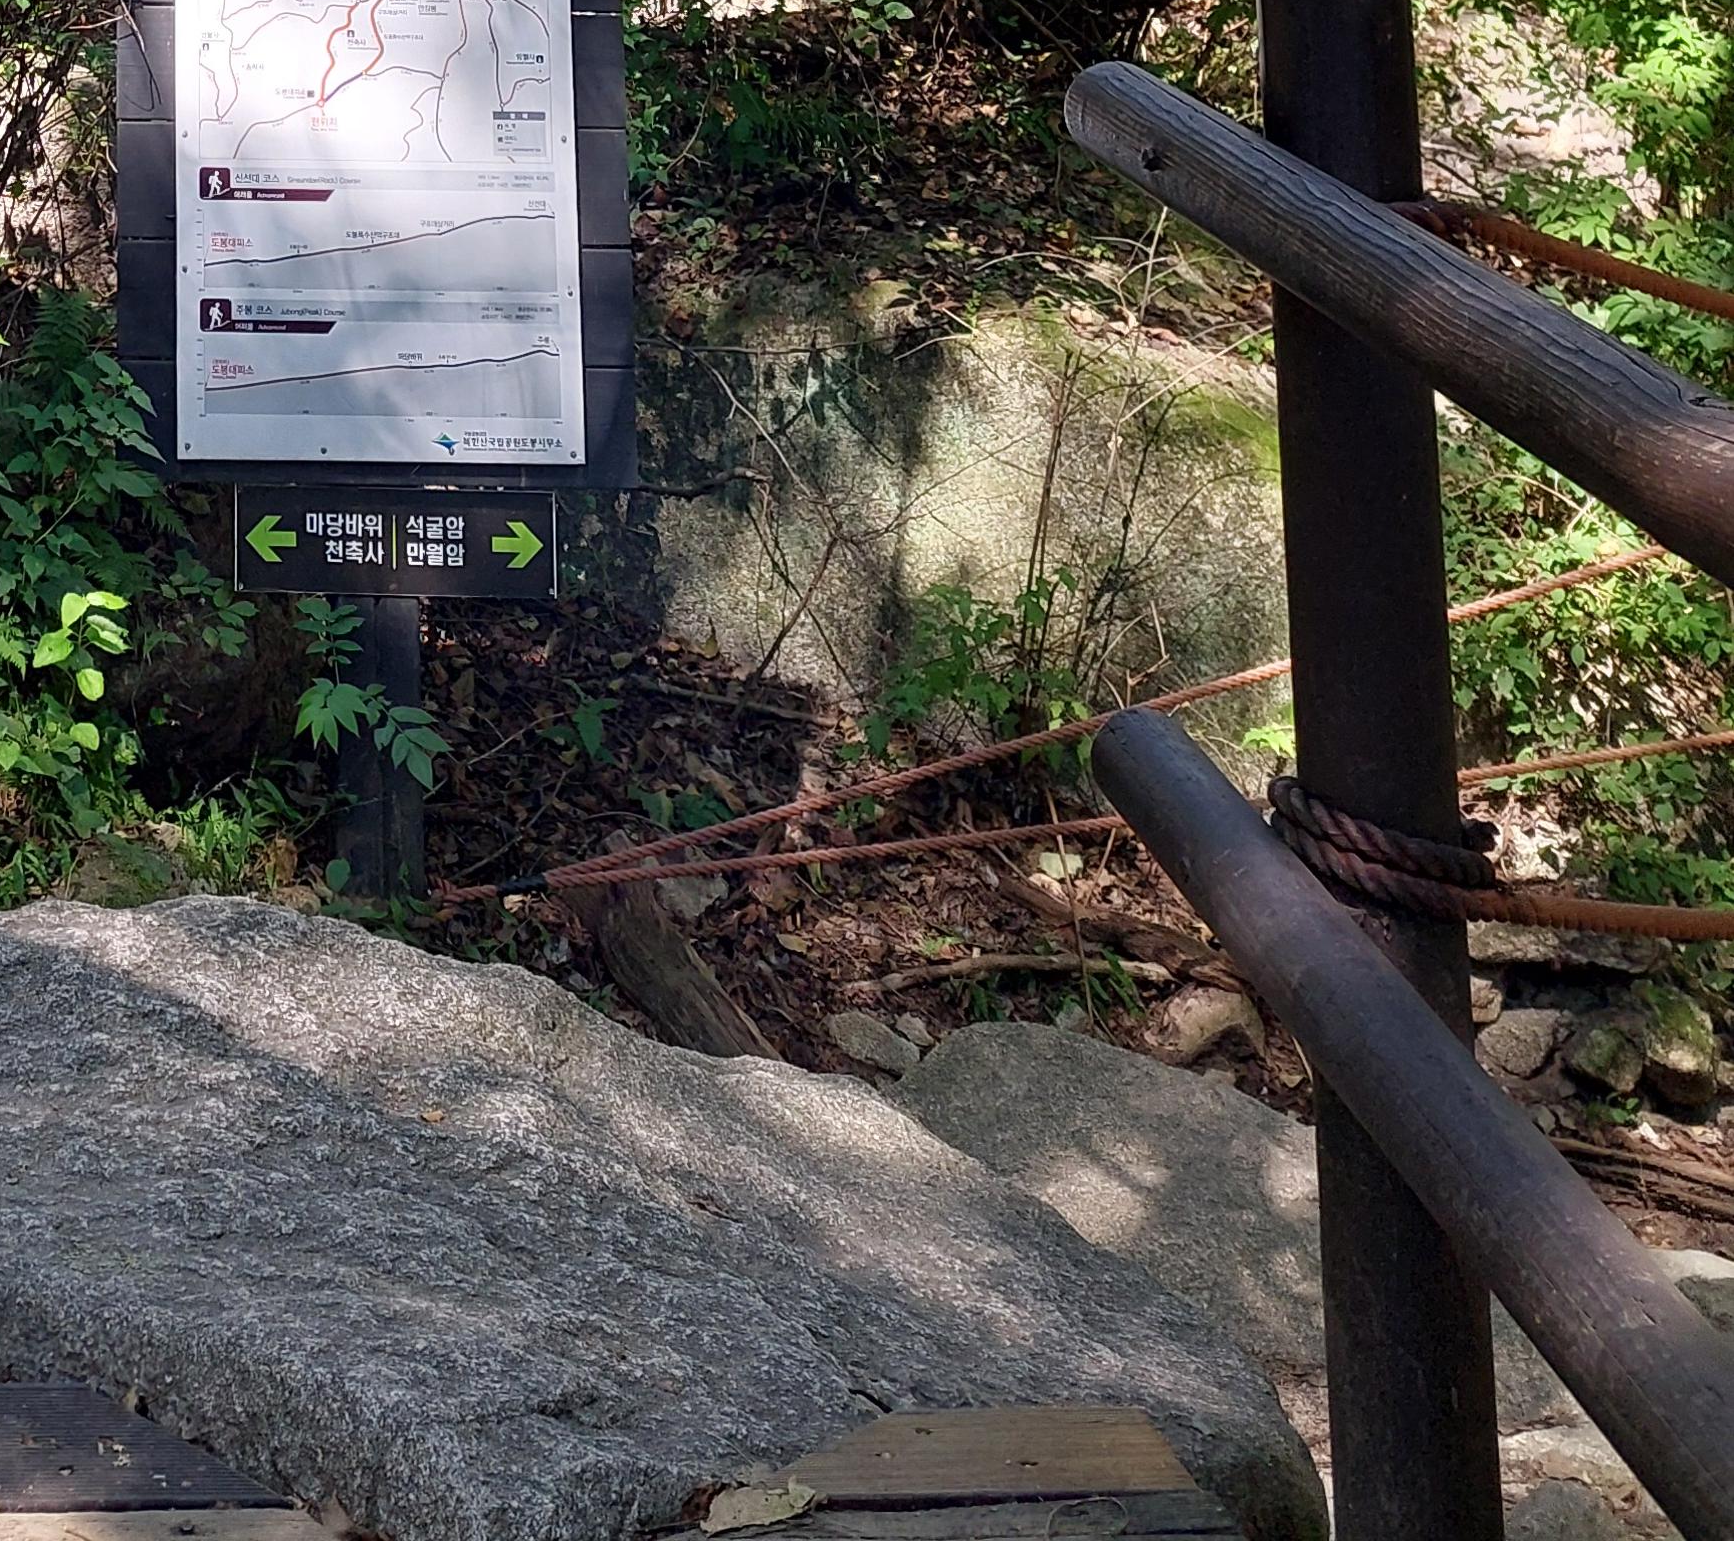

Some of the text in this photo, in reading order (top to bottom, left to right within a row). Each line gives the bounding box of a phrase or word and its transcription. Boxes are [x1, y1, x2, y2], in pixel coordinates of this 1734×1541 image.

[263, 174, 280, 183] 코스
[236, 304, 253, 315] 주봉
[256, 305, 273, 315] 코스
[324, 308, 346, 317] Course
[305, 512, 384, 539] 마당바위
[405, 515, 466, 541] 석굴암
[325, 540, 385, 565] 천축사
[405, 542, 466, 568] 만월암
